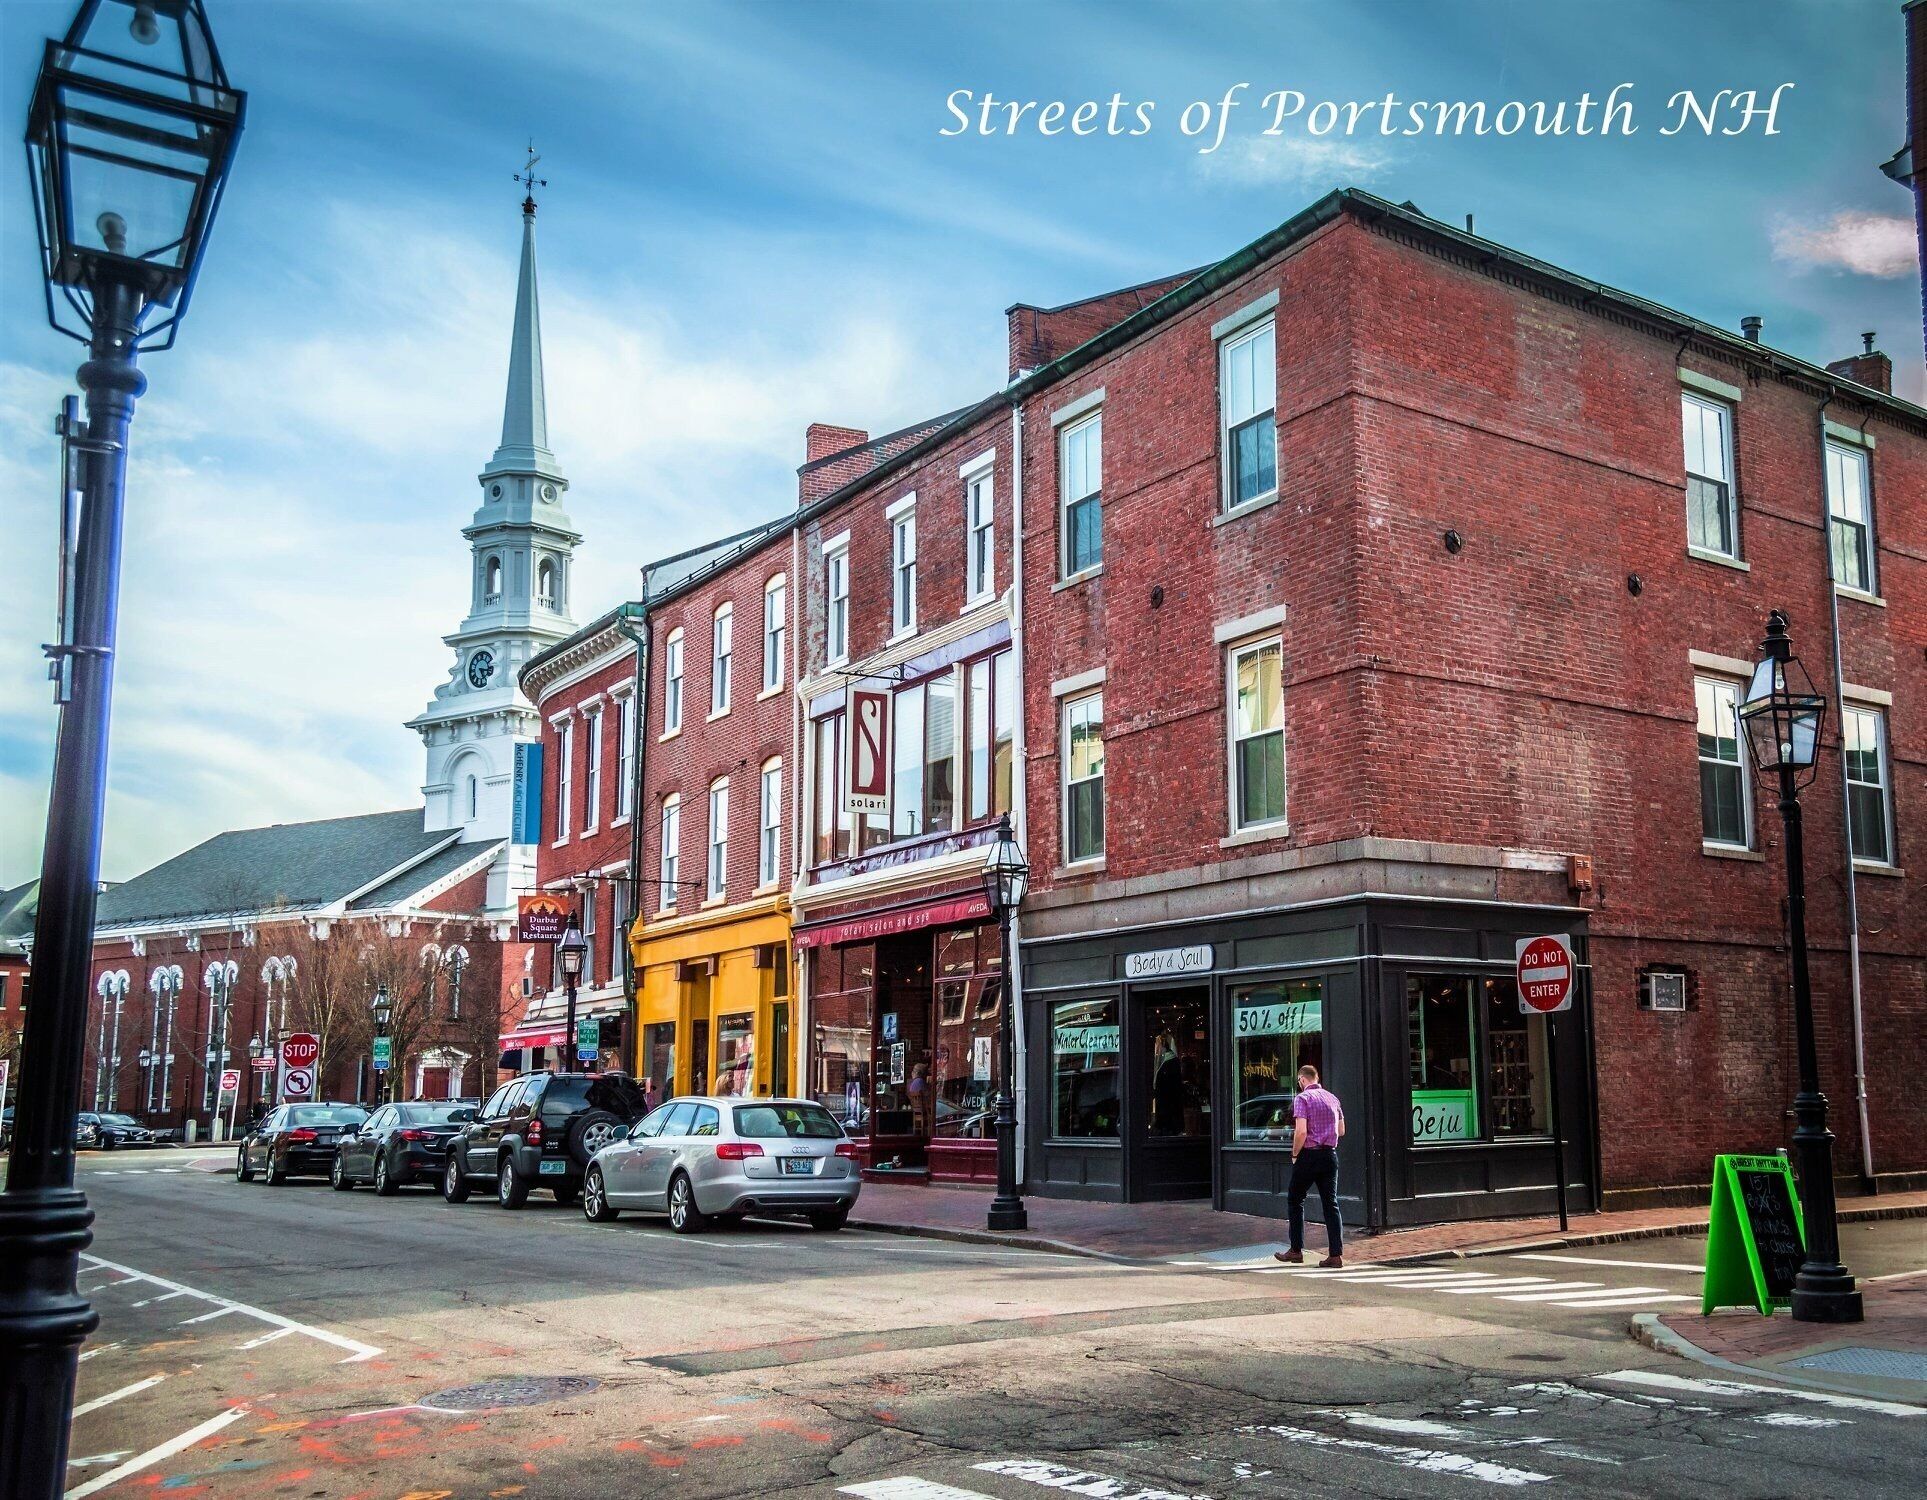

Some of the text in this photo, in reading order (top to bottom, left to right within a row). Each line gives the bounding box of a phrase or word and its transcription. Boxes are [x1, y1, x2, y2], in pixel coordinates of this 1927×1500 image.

[512, 743, 524, 842] McHENRY ARCHITECTURE
[850, 798, 886, 809] solari
[967, 902, 989, 914] AVEDA
[529, 916, 558, 924] Durbar
[530, 924, 558, 932] Square
[869, 920, 894, 932] salon
[896, 915, 912, 927] and
[915, 912, 930, 925] spa
[522, 931, 563, 939] Restauran
[1132, 953, 1165, 975] Body
[1177, 947, 1203, 971] Soul
[1525, 950, 1563, 966] DO NOT
[1530, 984, 1560, 998] ENTER
[1239, 1003, 1306, 1032] 50% off!
[1055, 1028, 1119, 1050] Winter Clearanc
[285, 1044, 317, 1058] STOP
[1411, 1105, 1463, 1139] Beju
[1748, 1174, 1771, 1195] 157
